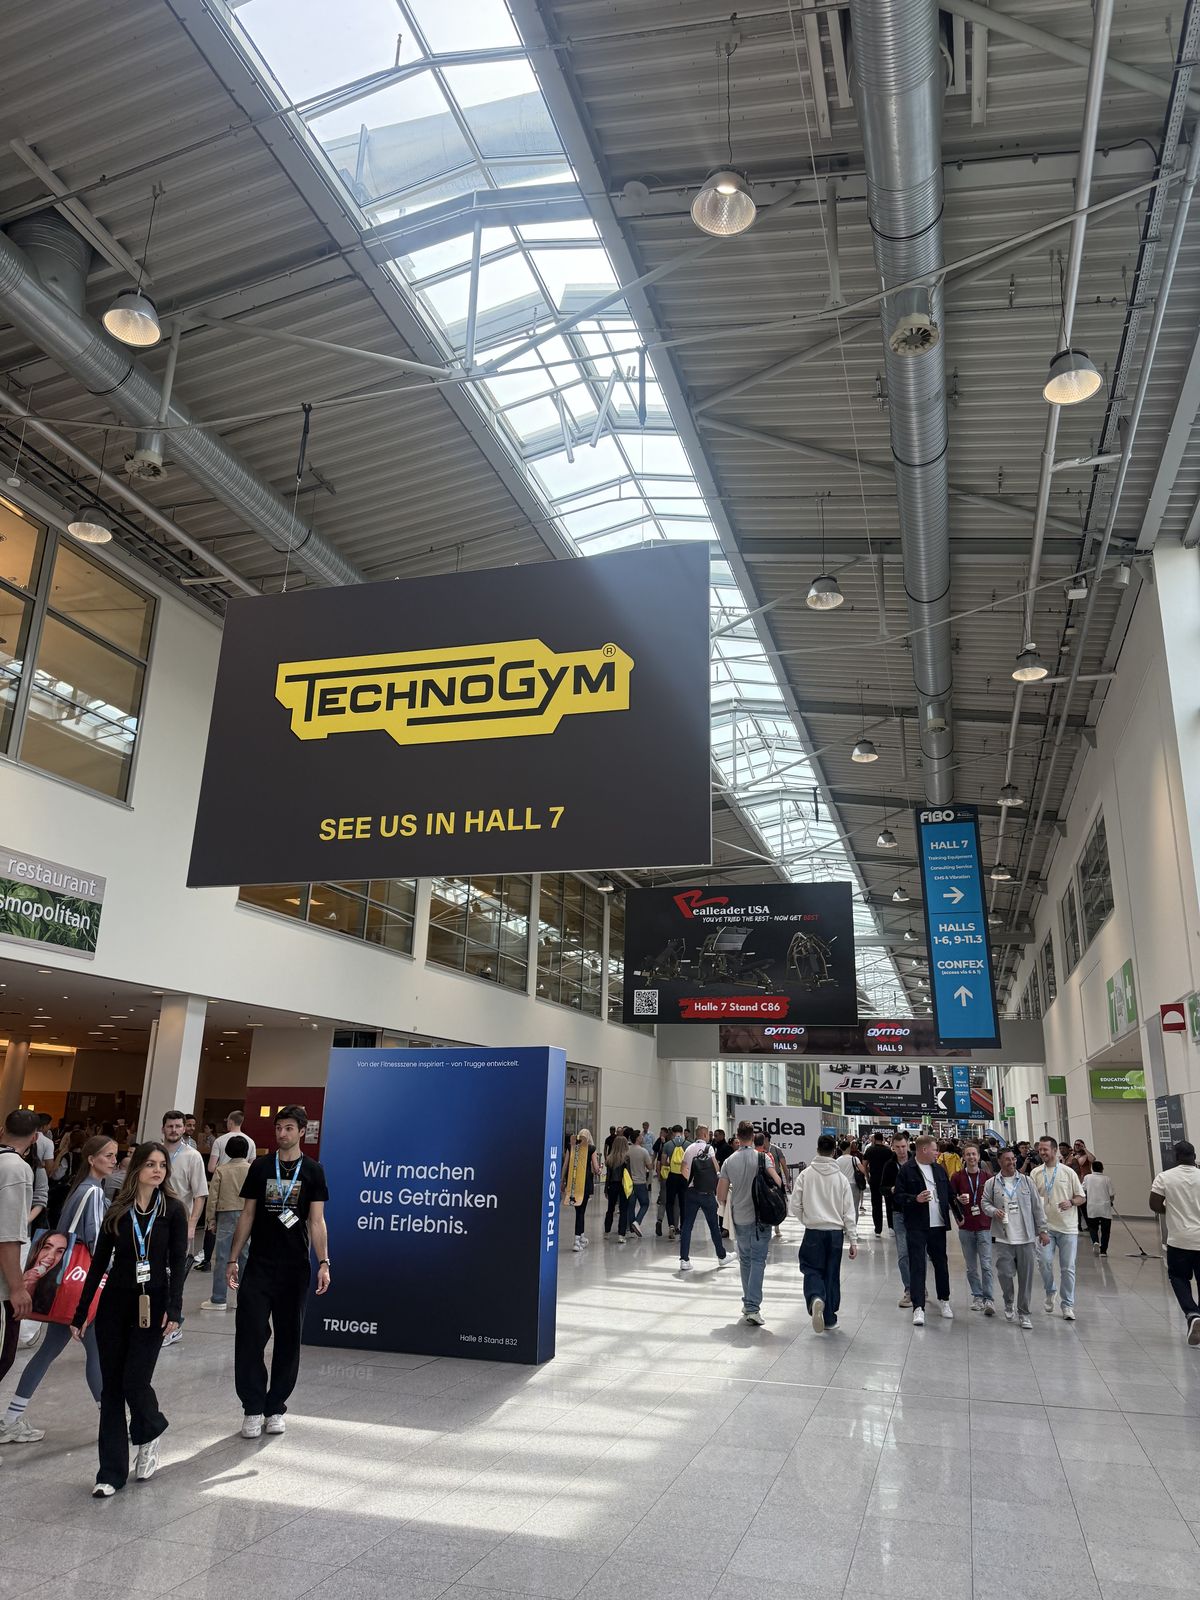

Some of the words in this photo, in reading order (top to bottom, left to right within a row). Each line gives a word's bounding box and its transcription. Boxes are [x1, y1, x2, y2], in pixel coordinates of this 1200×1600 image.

[920, 810, 954, 823] FIBO
[319, 816, 372, 840] SEE
[380, 814, 417, 837] US
[426, 812, 455, 835] IN
[465, 807, 542, 833] HALL
[549, 806, 565, 828] 7
[930, 841, 960, 850] HALL
[961, 840, 969, 848] 7
[7, 858, 97, 896] restaurant
[748, 905, 770, 914] USA
[939, 923, 976, 932] HALLS
[933, 936, 952, 946] 1-6,
[954, 935, 983, 944] 9-11.3
[937, 960, 984, 969] CONFEX
[694, 1002, 718, 1011] Halle
[720, 1003, 727, 1011] 7
[729, 1002, 758, 1011] Stand
[760, 1003, 780, 1011] C86
[764, 1027, 805, 1036] gym80
[866, 1028, 910, 1037] gym80
[418, 1061, 444, 1069] inspiriert
[464, 1061, 485, 1069] Trugge
[836, 1077, 902, 1090] JERAI
[752, 1117, 806, 1136] sidea
[362, 1160, 392, 1178] Wir
[396, 1162, 475, 1181] machen
[359, 1189, 393, 1205] aus
[398, 1188, 498, 1209] Getränken
[547, 1146, 558, 1252] TRUGGE
[357, 1212, 385, 1231] ein
[390, 1214, 468, 1235] Erlebnis.
[323, 1318, 378, 1334] TRUGGE
[459, 1334, 477, 1343] Halle
[477, 1335, 483, 1343] 8
[483, 1336, 504, 1345] Stand
[505, 1338, 518, 1346] B32
